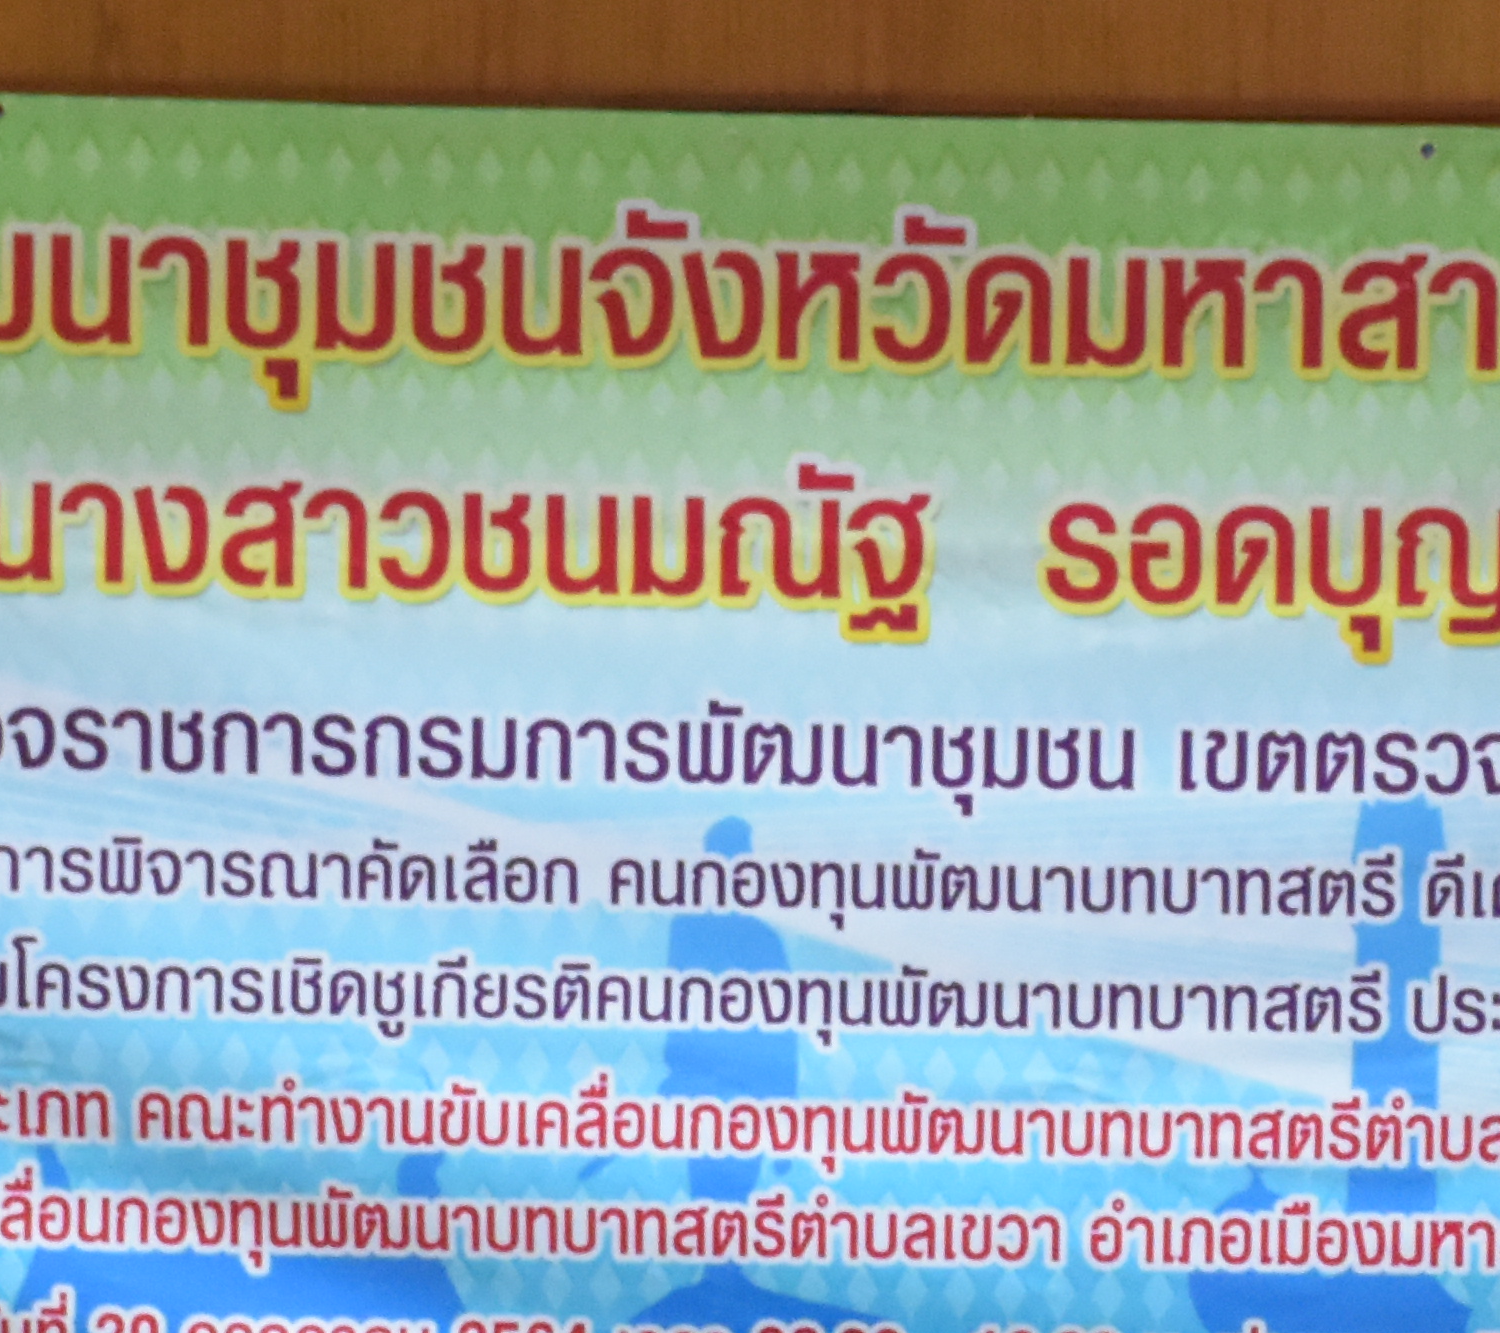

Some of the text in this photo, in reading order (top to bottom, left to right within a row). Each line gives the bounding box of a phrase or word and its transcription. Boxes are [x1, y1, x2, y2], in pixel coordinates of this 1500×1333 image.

[610, 847, 1396, 931] คนกองทุนพัฒนาบทบาทสตรี
